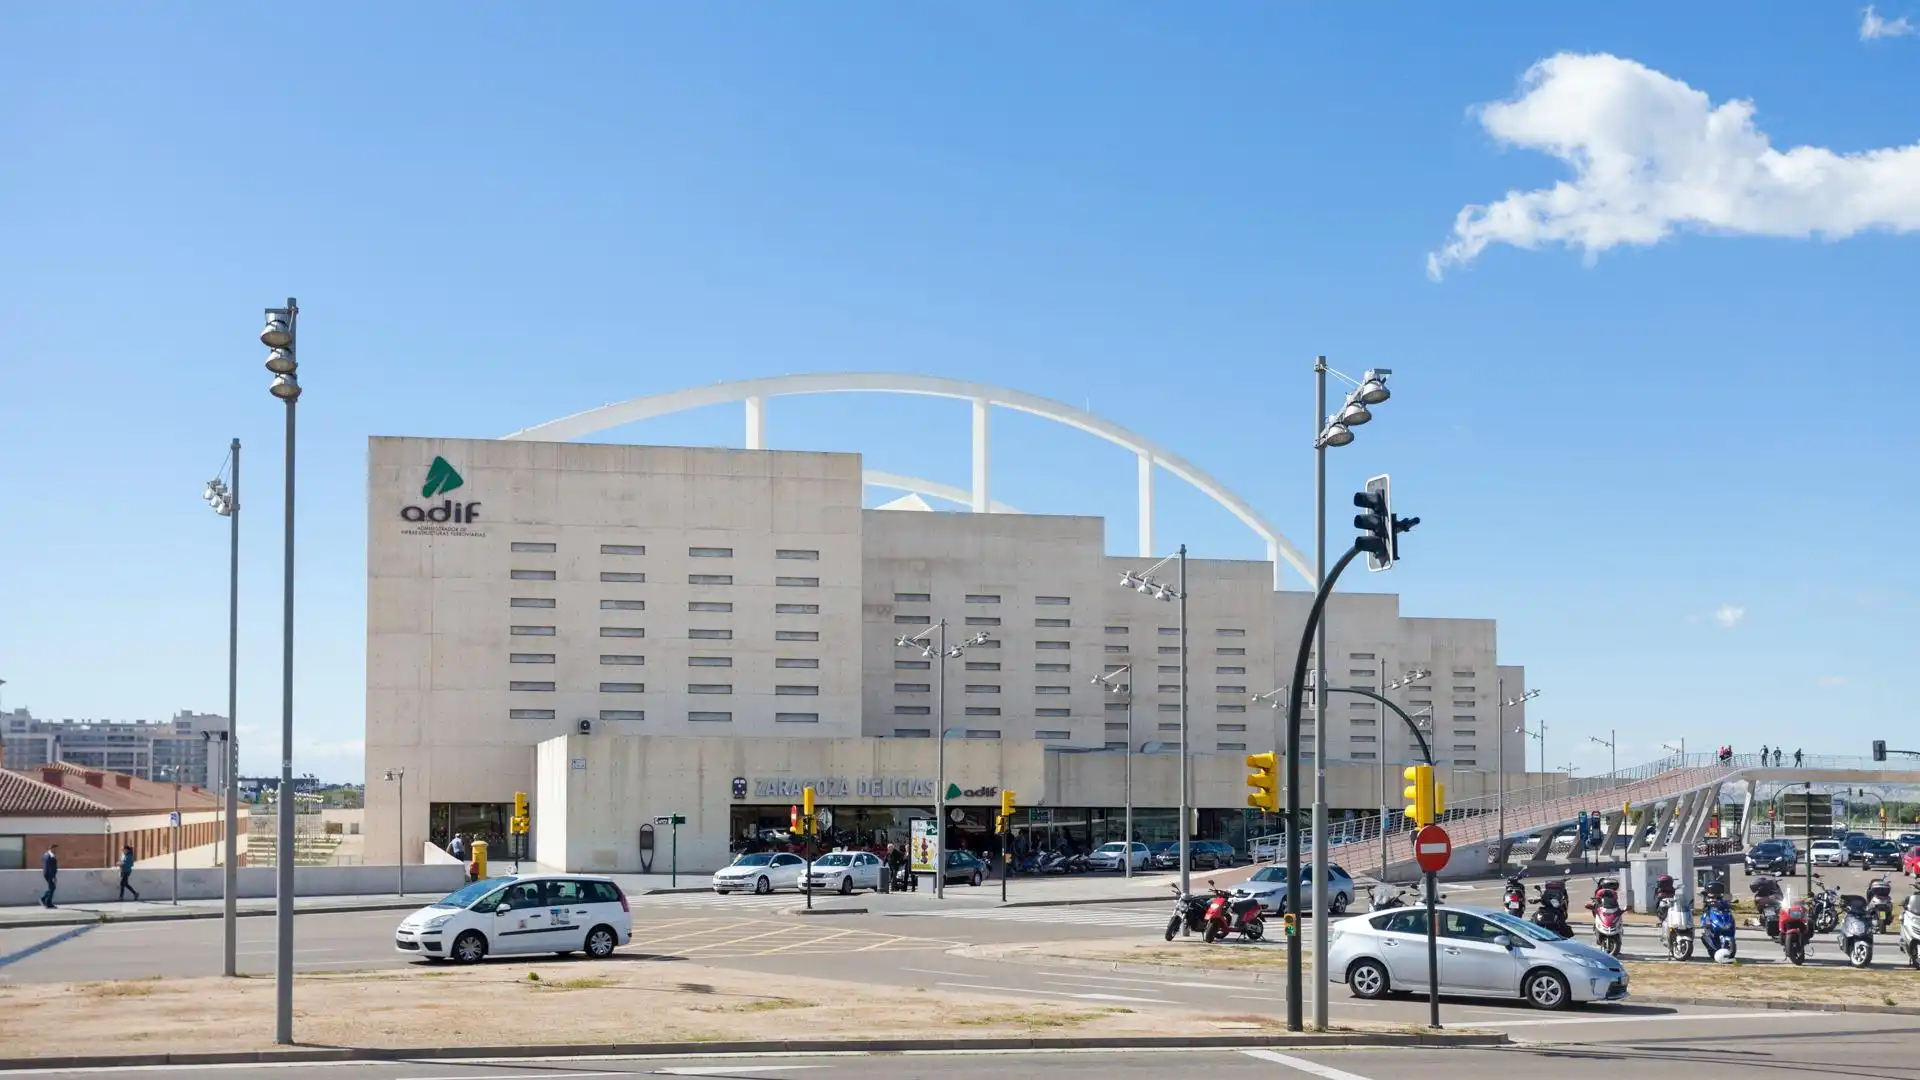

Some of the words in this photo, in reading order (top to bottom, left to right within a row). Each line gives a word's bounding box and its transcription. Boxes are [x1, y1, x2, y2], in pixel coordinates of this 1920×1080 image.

[401, 500, 482, 523] adif
[857, 777, 935, 798] DELICIAS
[963, 786, 998, 798] adif
